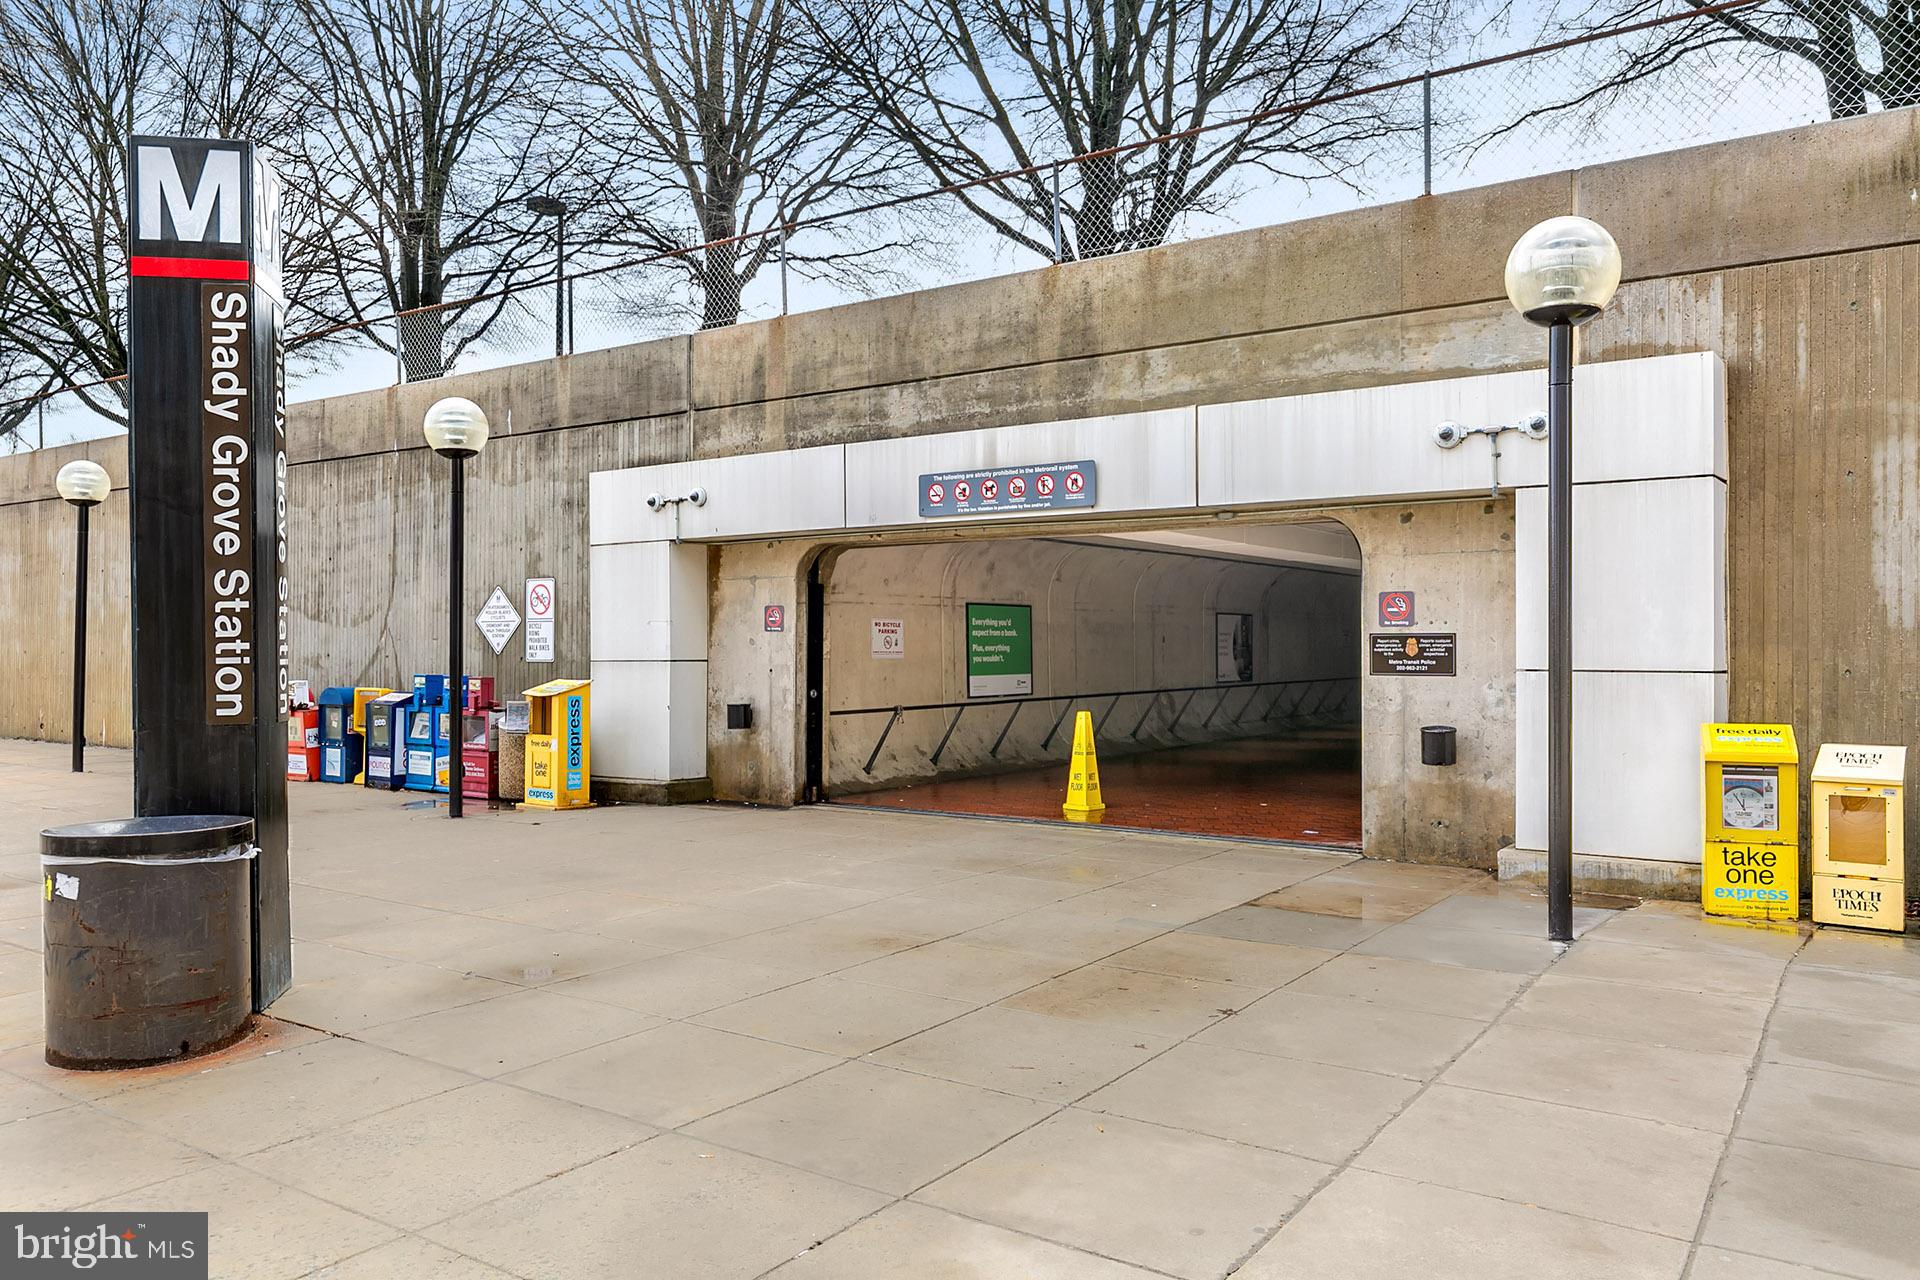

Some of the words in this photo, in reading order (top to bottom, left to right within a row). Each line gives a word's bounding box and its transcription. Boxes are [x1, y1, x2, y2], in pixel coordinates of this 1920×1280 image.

[138, 145, 242, 244] M
[204, 292, 248, 422] Shady
[212, 434, 248, 556] Grove
[276, 450, 287, 564] Grove
[972, 618, 998, 627] Everything
[999, 619, 1011, 627] you'd
[214, 568, 250, 716] Station
[278, 576, 288, 714] Station
[972, 644, 984, 652] Plus,
[985, 644, 1010, 652] everything
[570, 699, 582, 766] express
[541, 740, 552, 749] daily
[1836, 752, 1882, 760] EPOCH
[534, 761, 548, 770] take
[1071, 783, 1083, 791] FLOOR
[529, 789, 554, 800] express
[1722, 846, 1776, 867] take
[1726, 868, 1774, 885] one
[1714, 887, 1789, 901] express
[1832, 888, 1882, 902] EPOCH
[1835, 899, 1879, 912] TIMES
